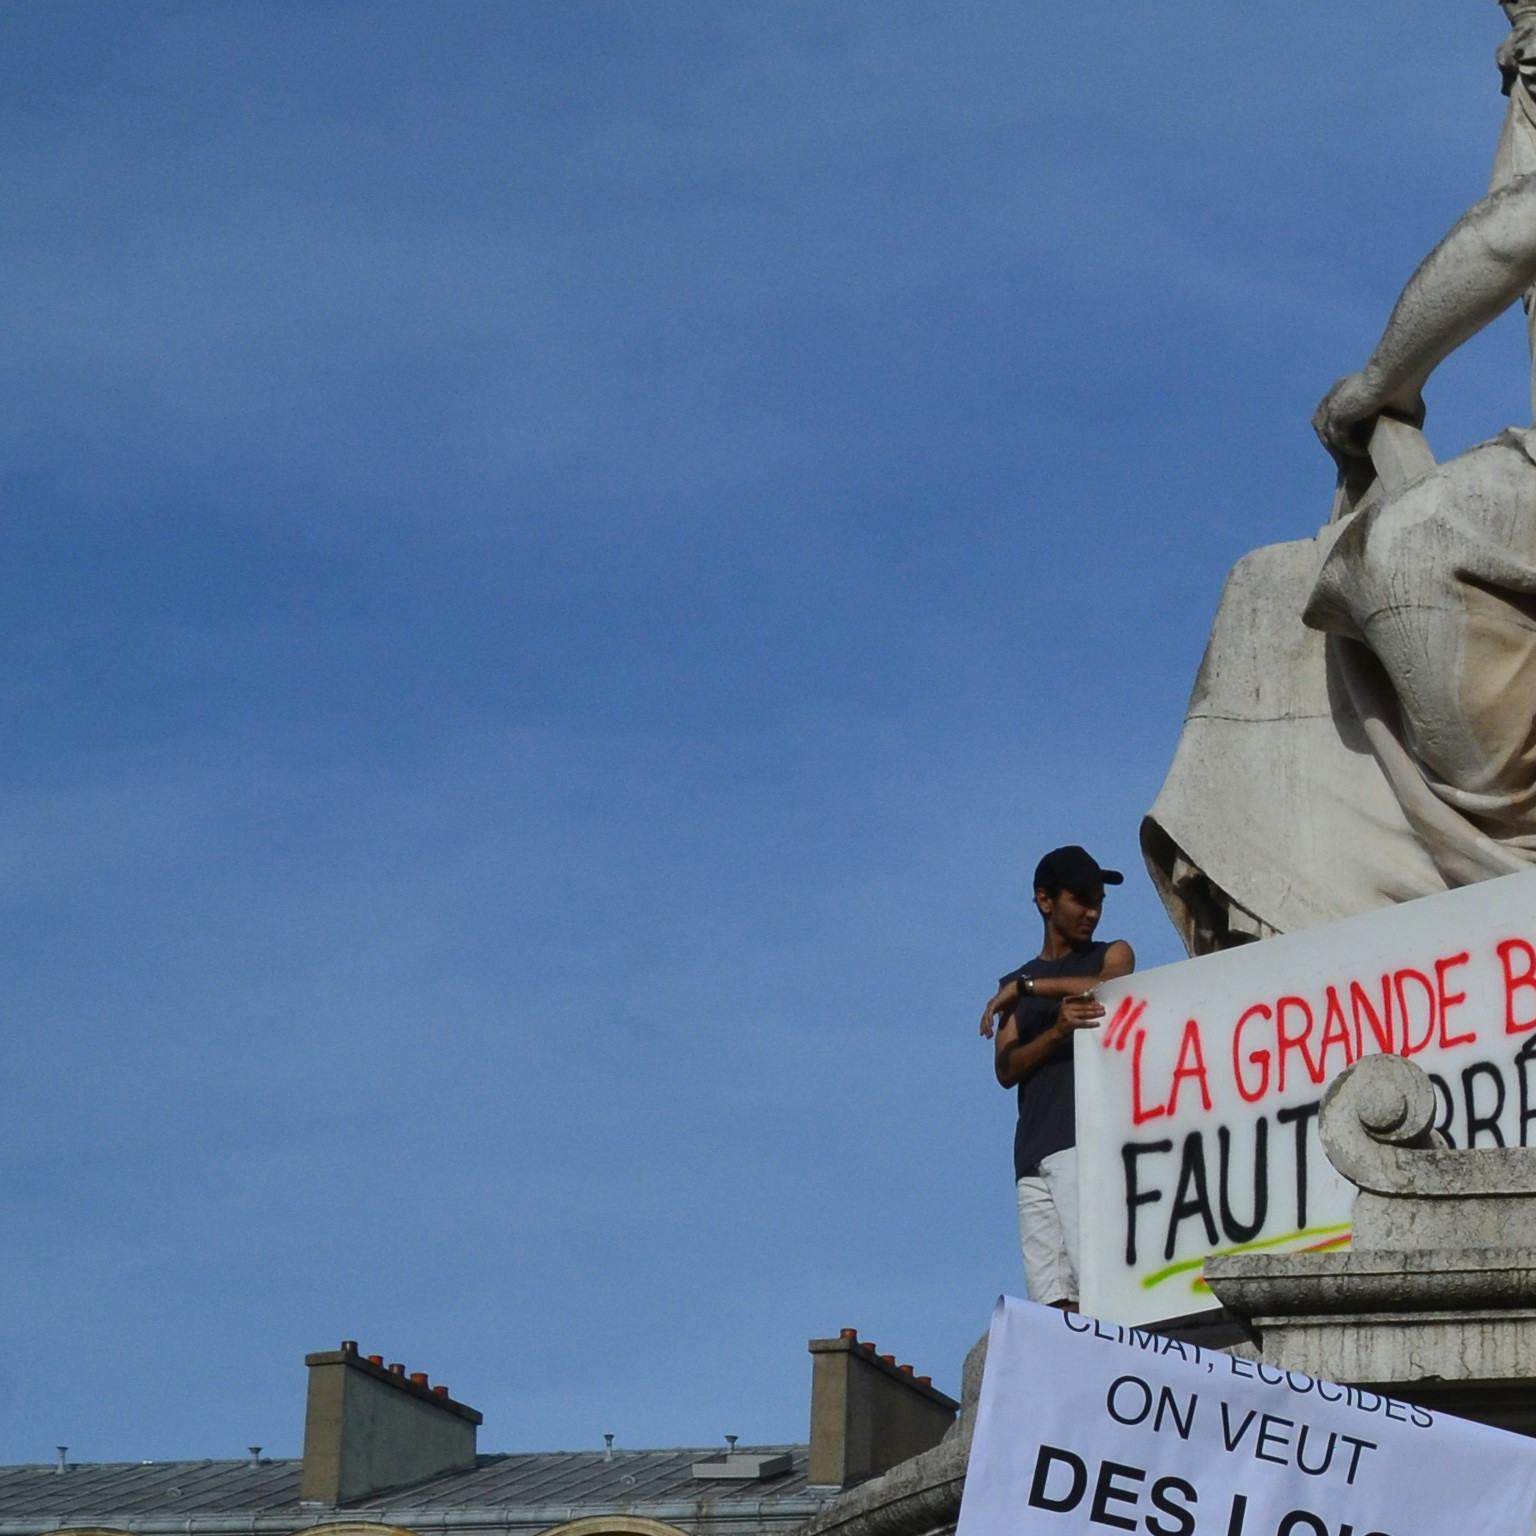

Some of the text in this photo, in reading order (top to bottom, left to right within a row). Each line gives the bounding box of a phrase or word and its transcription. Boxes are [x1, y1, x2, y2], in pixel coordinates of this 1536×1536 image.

[1232, 951, 1476, 1102] GRANDE
[1121, 1103, 1321, 1266] FAUT
[1106, 1374, 1377, 1485] ON VEUT
